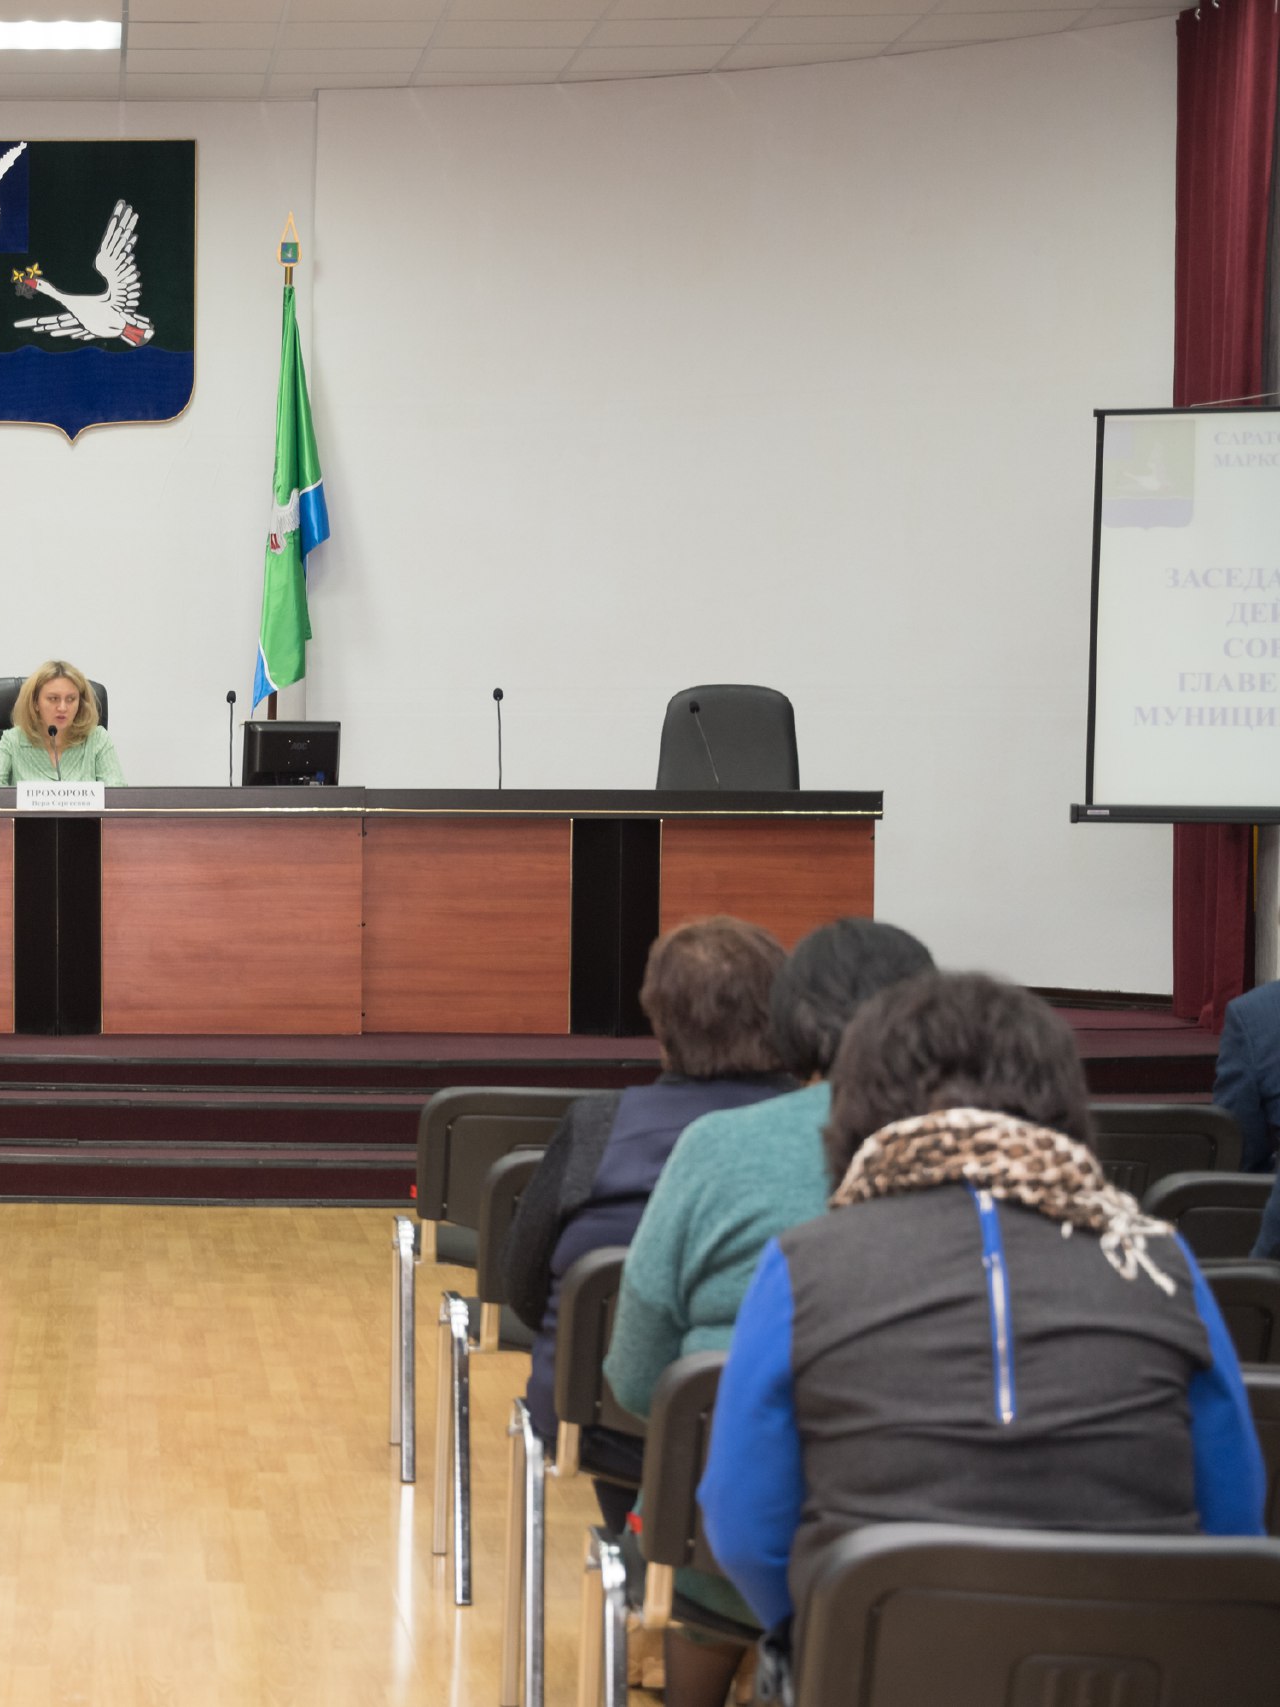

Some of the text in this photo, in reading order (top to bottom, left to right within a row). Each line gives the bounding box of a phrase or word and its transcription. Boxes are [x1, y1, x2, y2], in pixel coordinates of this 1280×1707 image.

[1214, 431, 1280, 445] САРАТ
[1165, 567, 1280, 592] ЗАСЕДА
[1178, 672, 1278, 693] ГЛАВЕ
[1133, 706, 1280, 731] МУНИЦИ
[26, 789, 96, 797] ПРОХОРОВА
